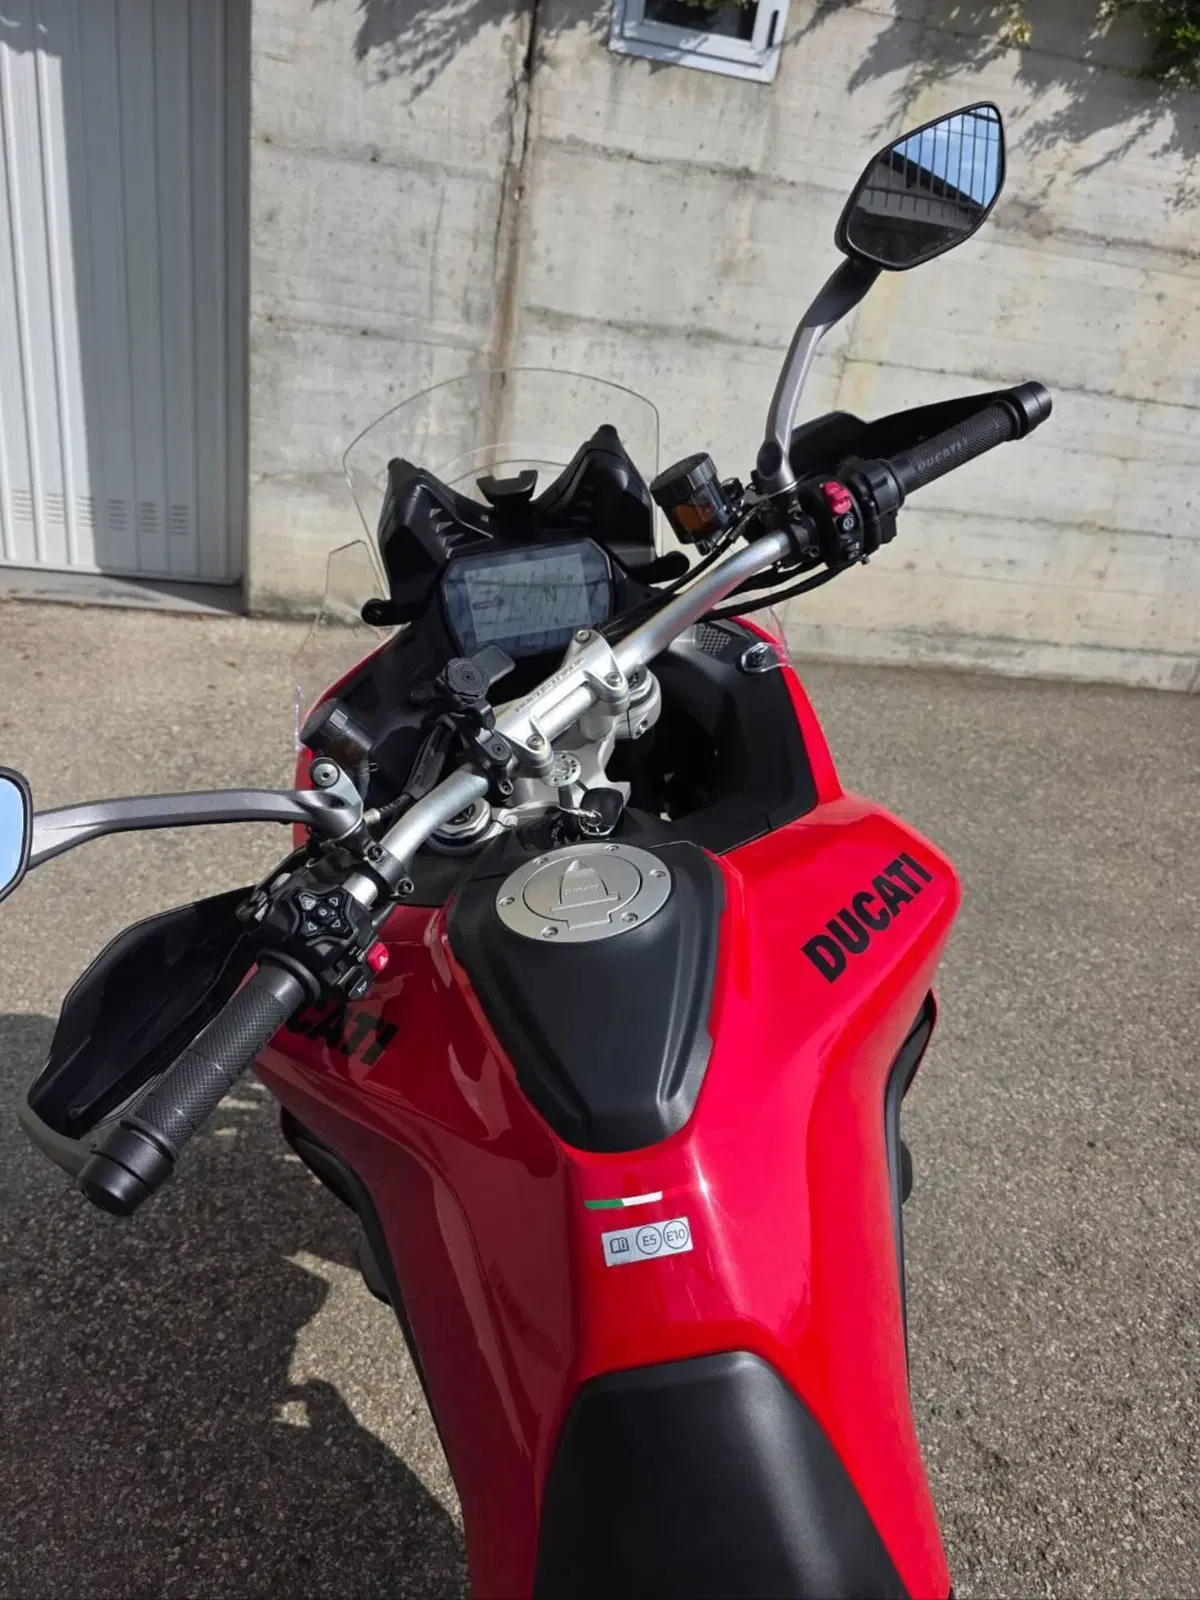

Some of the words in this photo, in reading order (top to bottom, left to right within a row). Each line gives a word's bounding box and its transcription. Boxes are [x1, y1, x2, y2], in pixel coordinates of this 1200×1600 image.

[801, 852, 933, 984] DUCATI
[287, 1001, 399, 1066] CATI
[642, 1235, 657, 1247] E5
[666, 1228, 685, 1242] E10
